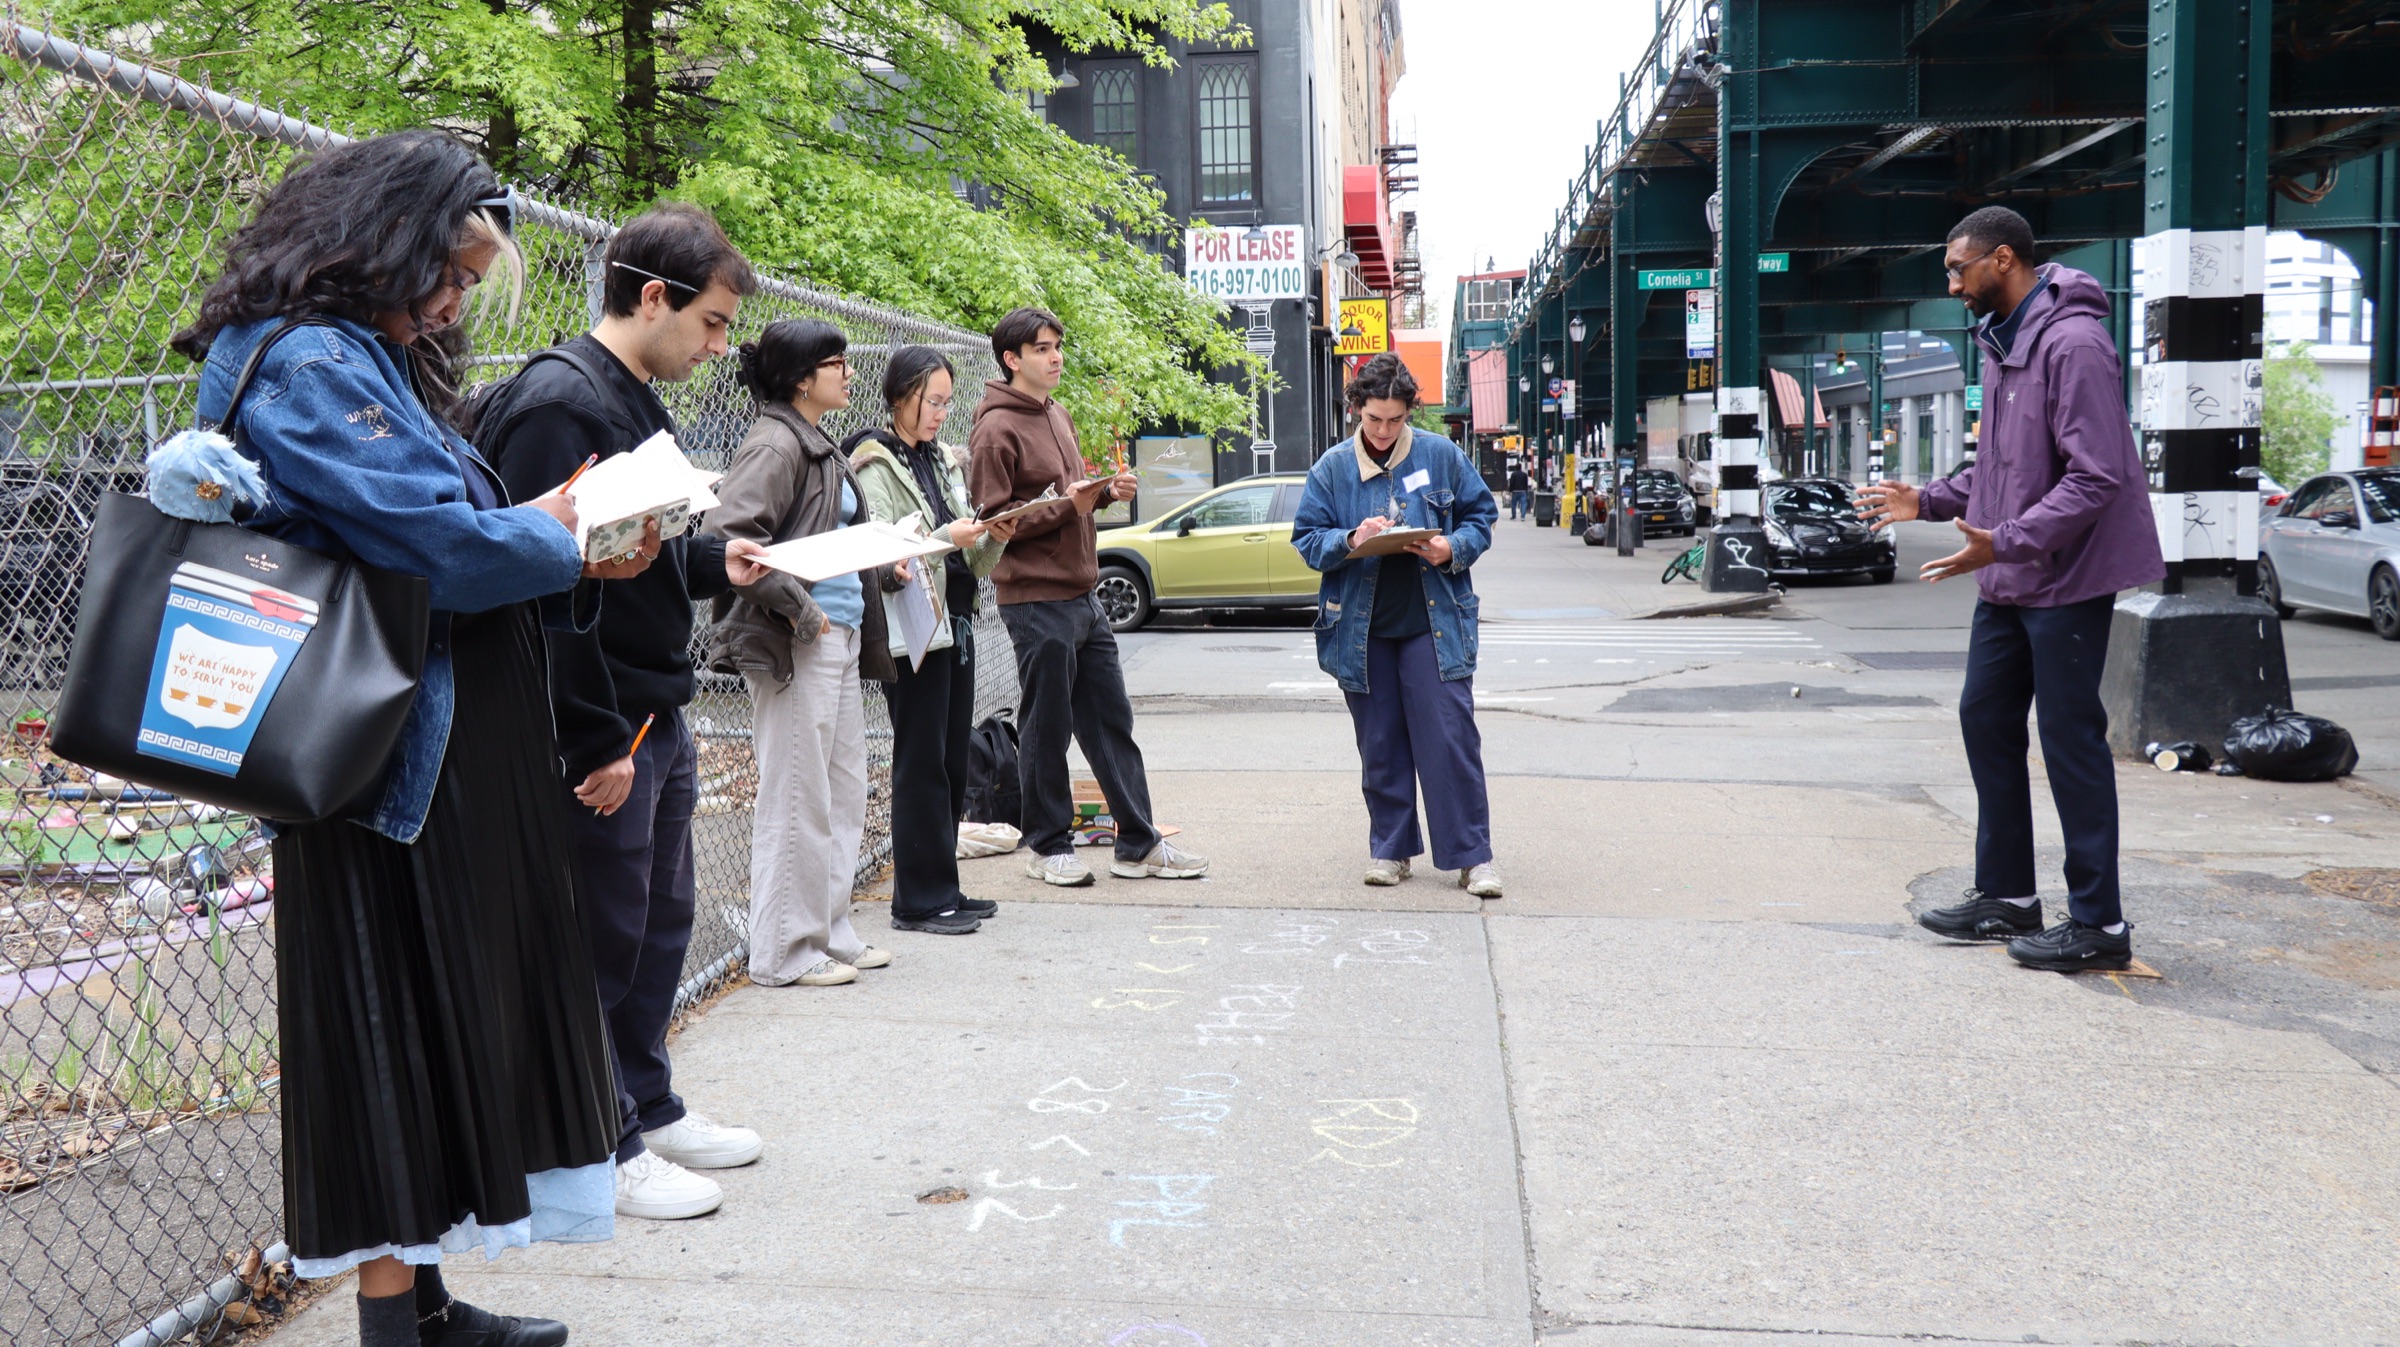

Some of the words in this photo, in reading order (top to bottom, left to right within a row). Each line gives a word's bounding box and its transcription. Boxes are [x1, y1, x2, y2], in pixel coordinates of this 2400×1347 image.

[1194, 231, 1231, 263] FOR
[1236, 230, 1295, 262] LEASE
[1190, 266, 1301, 295] 516-997-0100
[1647, 272, 1692, 287] Cornelia
[1695, 271, 1703, 281] St
[1339, 303, 1383, 324] LIQUOR
[1340, 335, 1382, 351] WINE
[173, 665, 188, 677] TO
[193, 671, 225, 687] SERVE
[230, 680, 255, 695] YOU
[179, 652, 196, 665] WE
[198, 658, 218, 671] ARE
[221, 663, 258, 681] HAPPY
